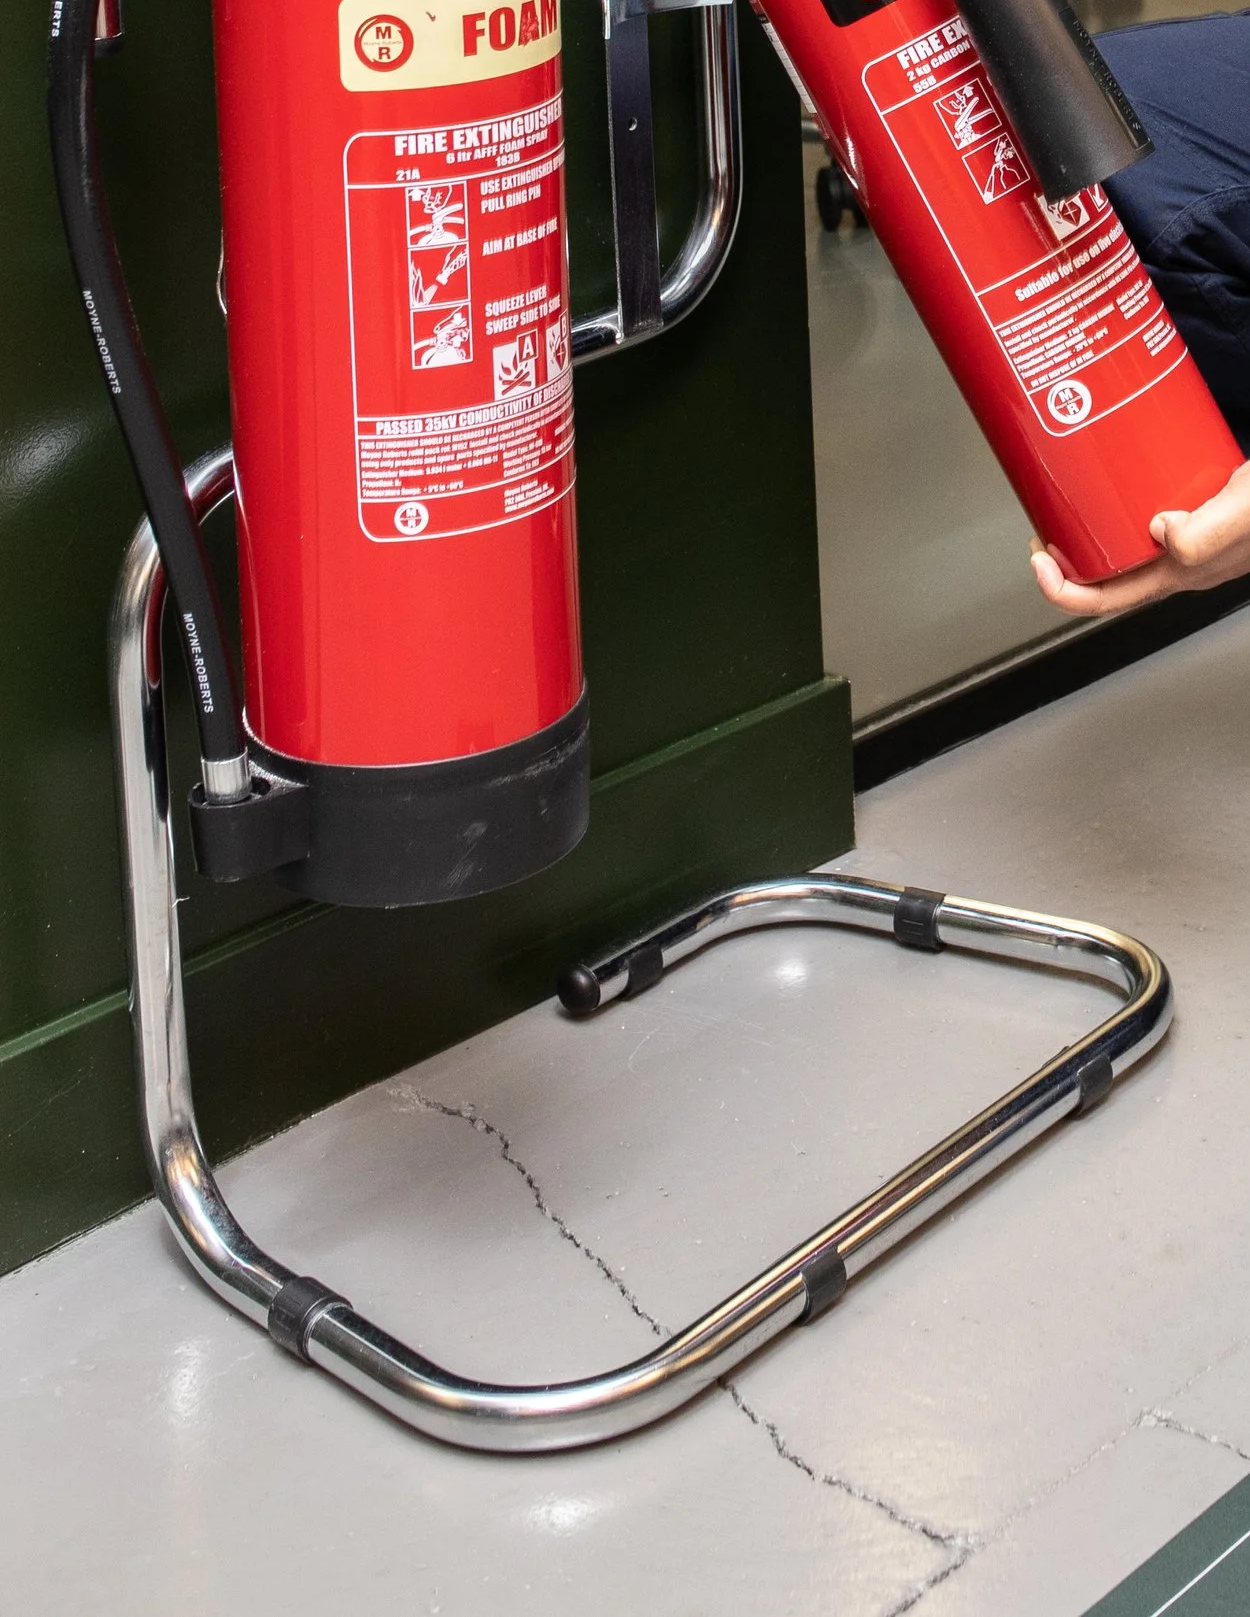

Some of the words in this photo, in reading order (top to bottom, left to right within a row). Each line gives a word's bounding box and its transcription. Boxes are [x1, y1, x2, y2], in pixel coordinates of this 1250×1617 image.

[376, 26, 392, 39] M
[378, 47, 391, 60] R
[896, 32, 944, 70] FIRE
[906, 70, 916, 82] 2
[915, 63, 932, 77] kg
[930, 40, 970, 68] CARBON
[394, 129, 448, 156] FIRE
[446, 153, 456, 164] 6
[473, 145, 498, 160] AFFF
[500, 138, 525, 154] FOAM
[526, 128, 548, 147] SPRAY
[396, 168, 421, 182] 21A
[495, 151, 521, 168] 183B
[480, 178, 500, 195] USE
[501, 159, 553, 191] EXTINGUISHER
[480, 196, 505, 214] PULL
[506, 189, 527, 208] RING
[528, 184, 541, 202] PIN
[482, 239, 503, 256] AIM
[504, 235, 516, 251] AT
[516, 229, 537, 248] BASE
[538, 225, 546, 239] OF
[546, 217, 558, 236] FIRE
[1015, 270, 1060, 302] Suitable
[1058, 262, 1074, 278] for
[1072, 250, 1090, 269] use
[1089, 243, 1100, 258] on
[485, 294, 525, 317] SQUEEZE
[526, 284, 548, 305] LEVER
[485, 313, 519, 336] SWEEP
[520, 306, 539, 326] SIDE
[540, 301, 548, 317] TO
[548, 294, 561, 314] SIDE
[82, 290, 121, 394] MOYNE-ROBERTS
[521, 337, 534, 358] A
[376, 419, 423, 436] PASSED
[425, 415, 457, 432] 35kV
[459, 394, 532, 427] CONDUCTIVITY
[533, 389, 543, 406] OF
[183, 612, 214, 714] MOYNE-ROBERTS
